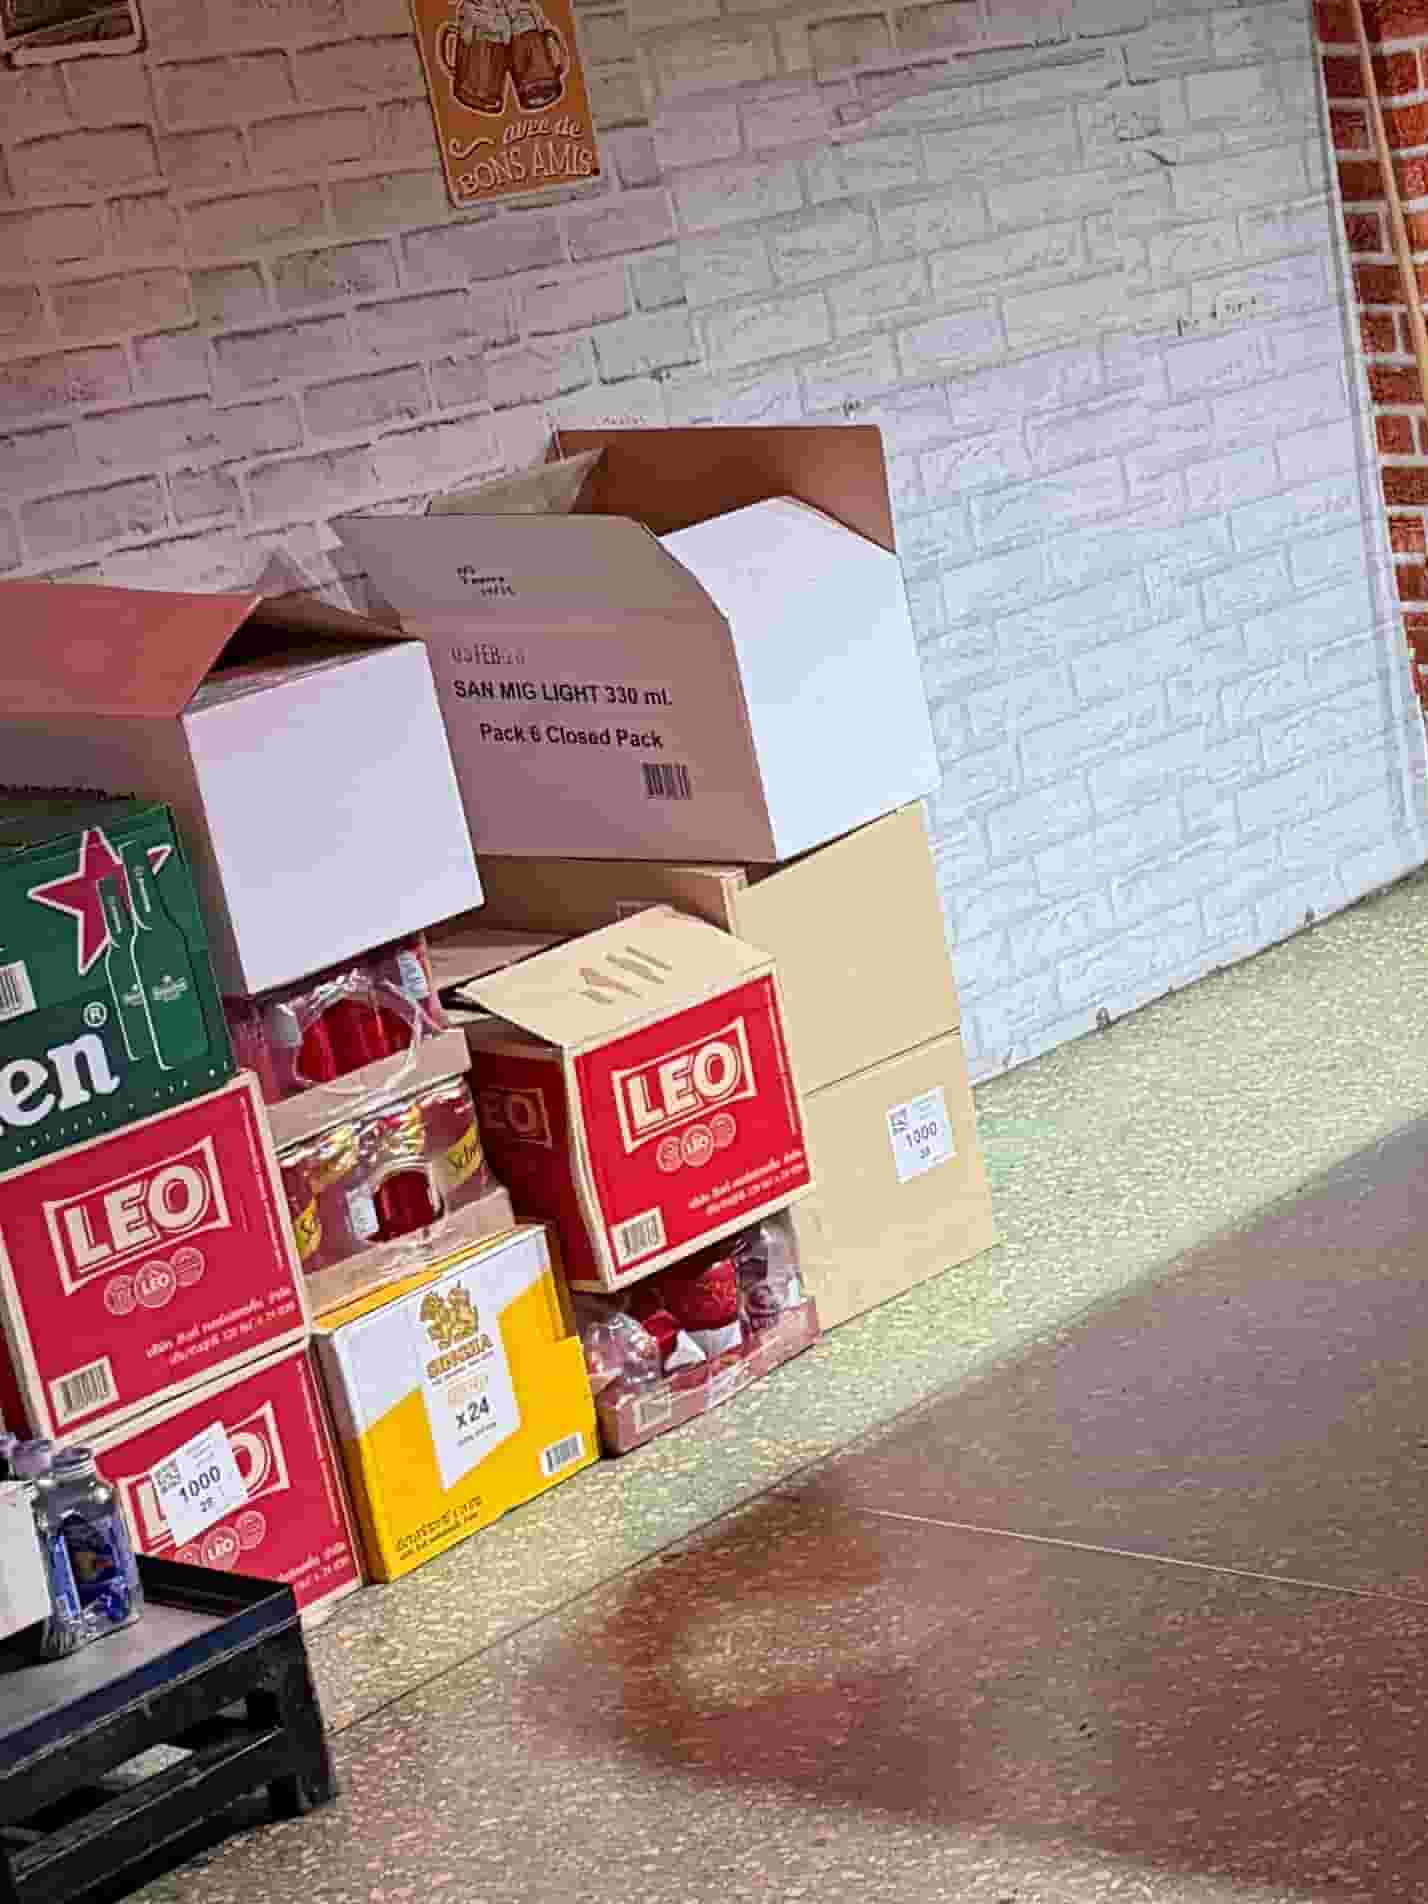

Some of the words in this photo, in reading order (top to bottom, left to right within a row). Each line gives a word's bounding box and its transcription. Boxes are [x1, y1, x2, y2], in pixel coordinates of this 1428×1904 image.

[456, 144, 527, 196] BONS
[453, 679, 494, 700] SAN
[500, 680, 537, 702] MIG
[542, 682, 599, 704] LIGHT
[605, 685, 638, 705] 330
[479, 722, 523, 742] Pack
[546, 724, 611, 746] Closed
[615, 728, 665, 749] Pack
[627, 1042, 741, 1135] LEO
[904, 1120, 937, 1148] 1000
[63, 1164, 211, 1273] LEO
[141, 1271, 170, 1296] LEO
[177, 1465, 222, 1504] 1000
[206, 1535, 234, 1562] LEO
